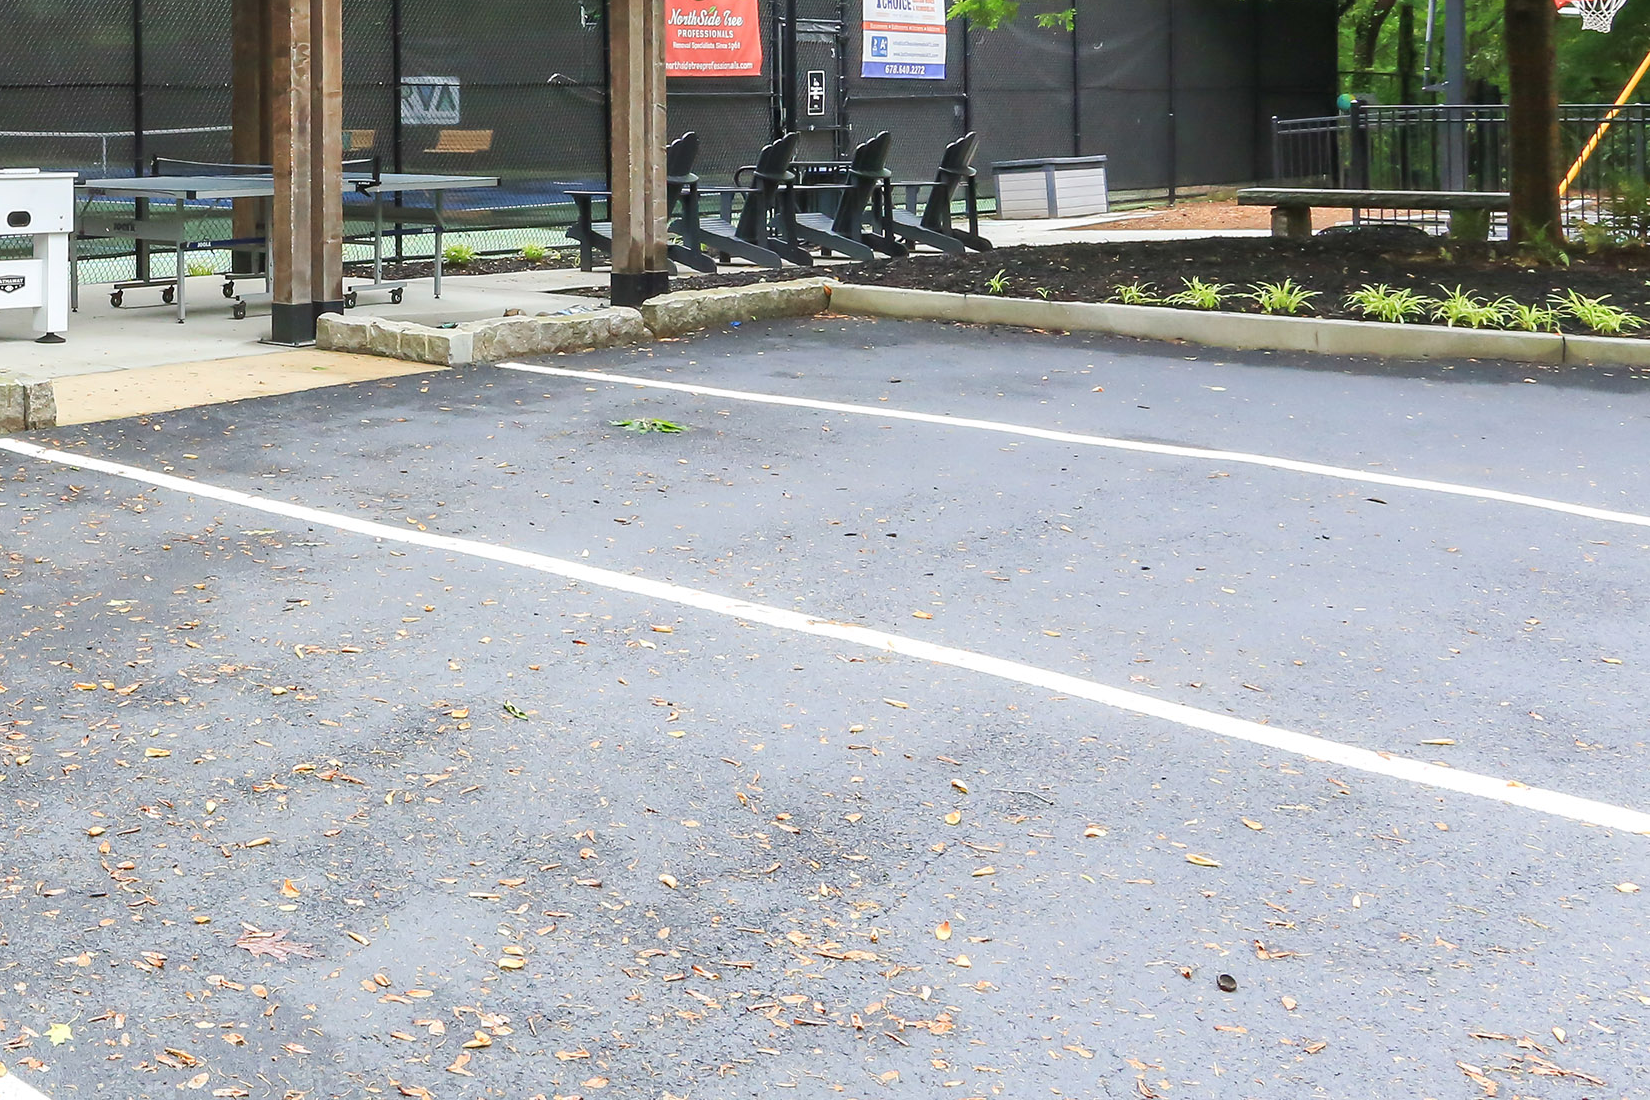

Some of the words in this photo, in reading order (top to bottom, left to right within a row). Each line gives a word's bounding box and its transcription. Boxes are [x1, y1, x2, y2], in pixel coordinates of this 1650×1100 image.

[667, 7, 722, 27] NorthSide
[723, 9, 744, 27] Tree
[677, 29, 734, 38] PROFESSIONALS
[885, 64, 926, 75] 678.640.2272
